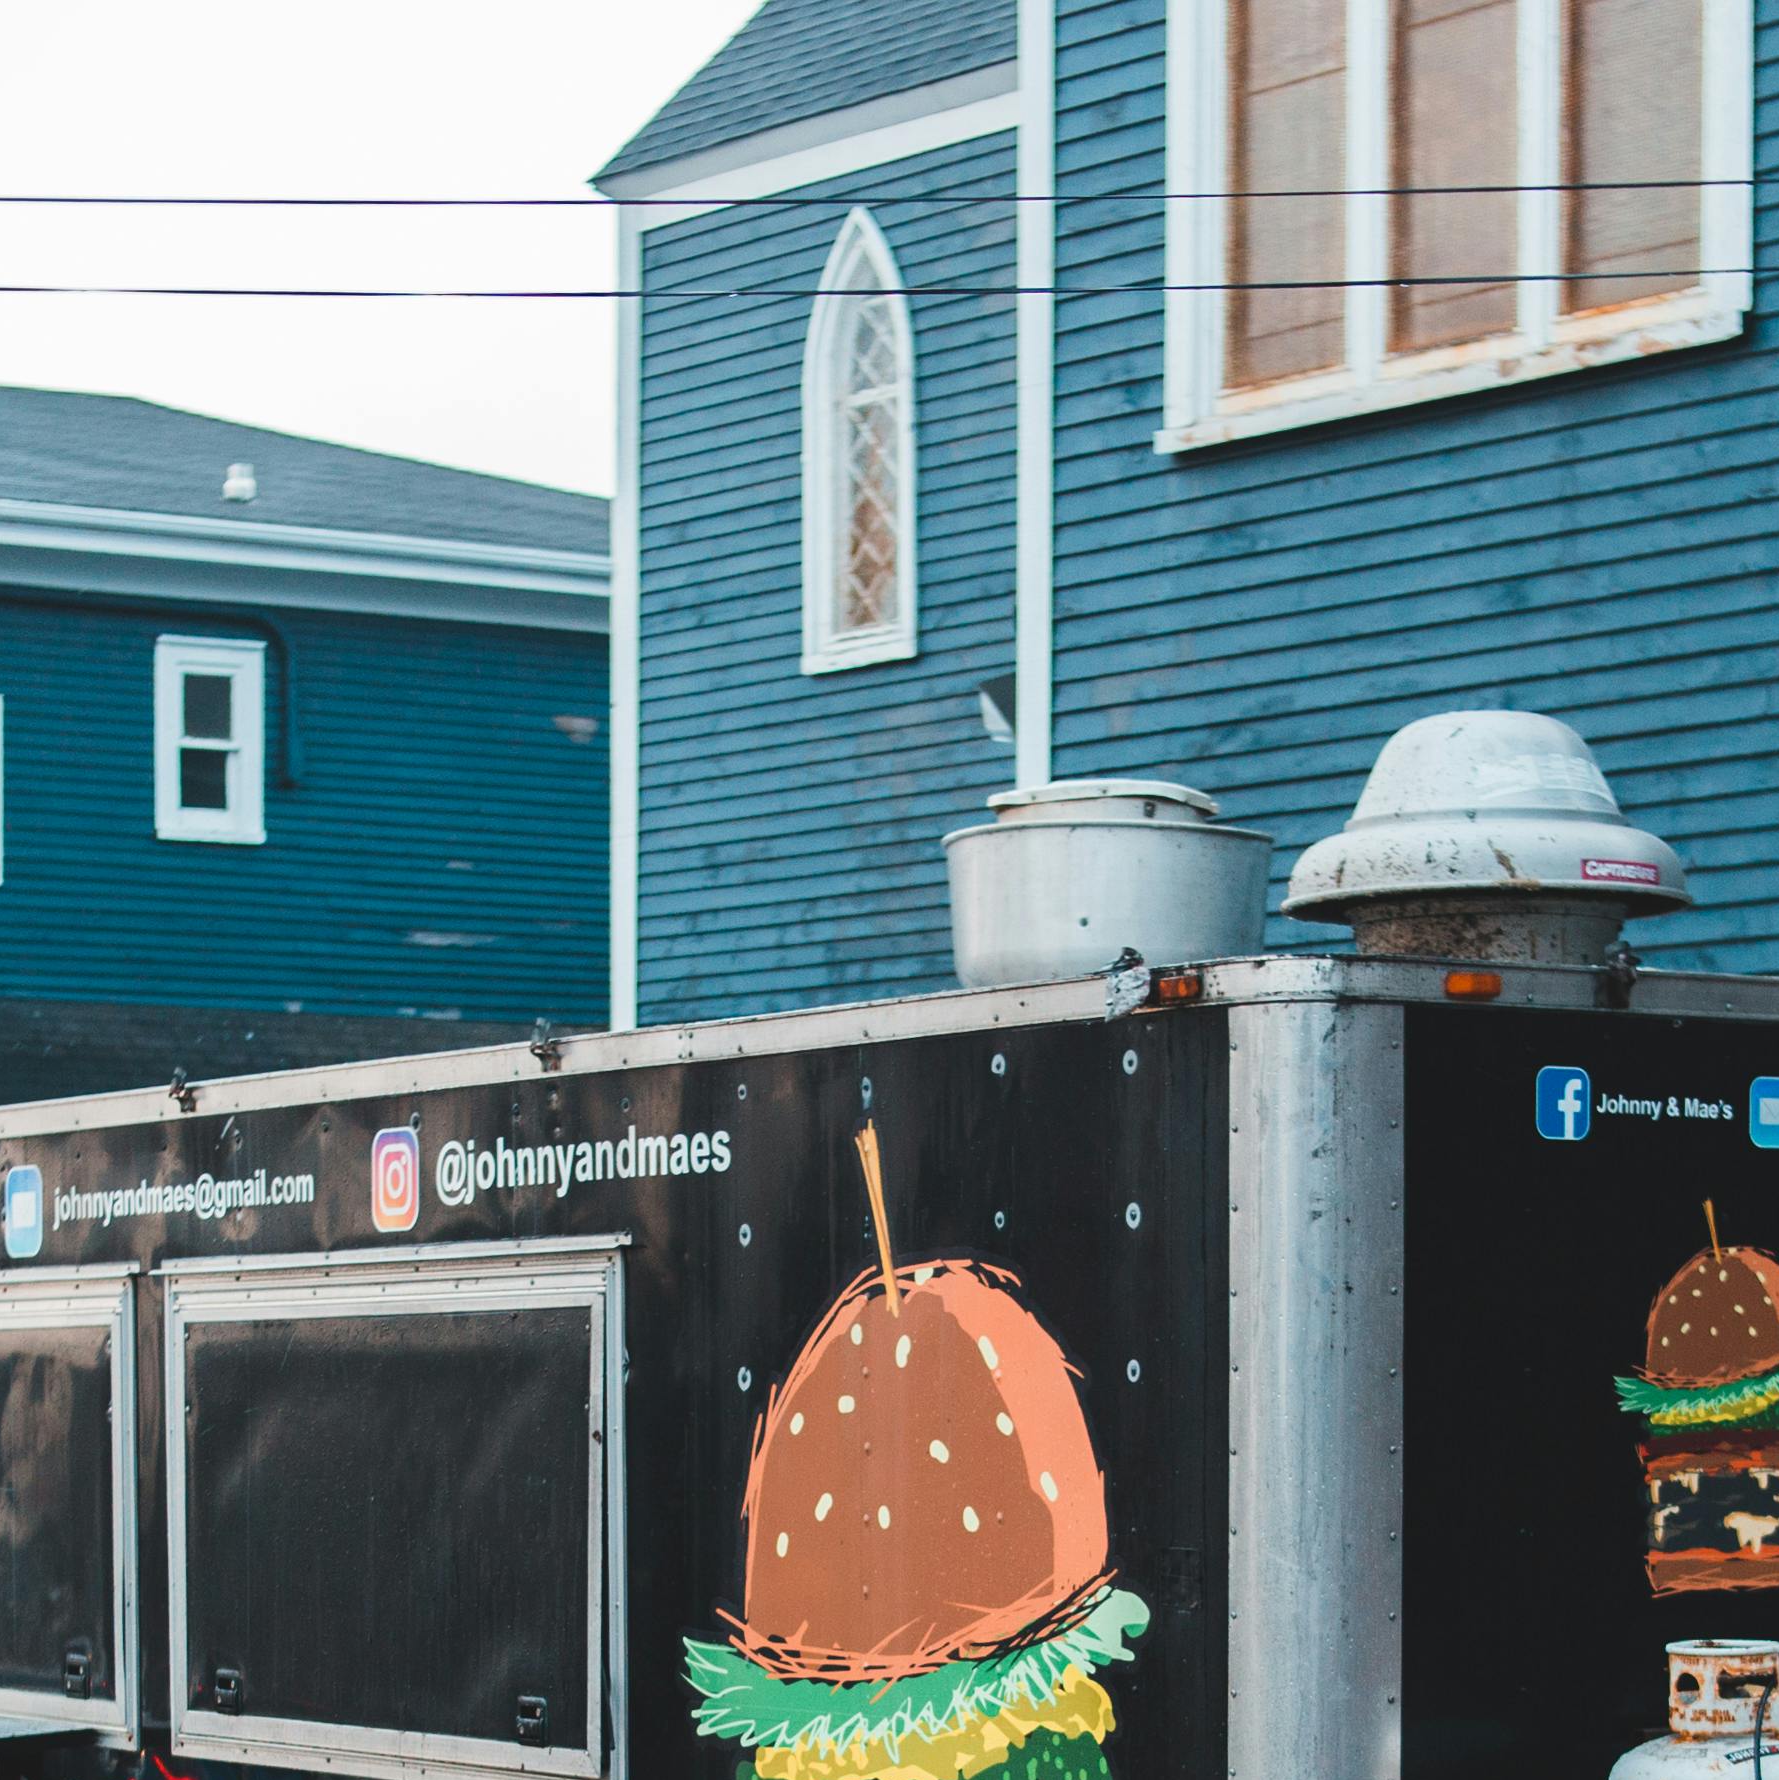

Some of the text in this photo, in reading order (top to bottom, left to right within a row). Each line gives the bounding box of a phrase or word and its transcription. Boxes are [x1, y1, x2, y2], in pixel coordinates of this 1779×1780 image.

[1596, 1093, 1734, 1121] Johnny & Mae's
[435, 1124, 731, 1207] @johnnyandmaes
[52, 1169, 315, 1231] johnnyandmaes@gmail.com
